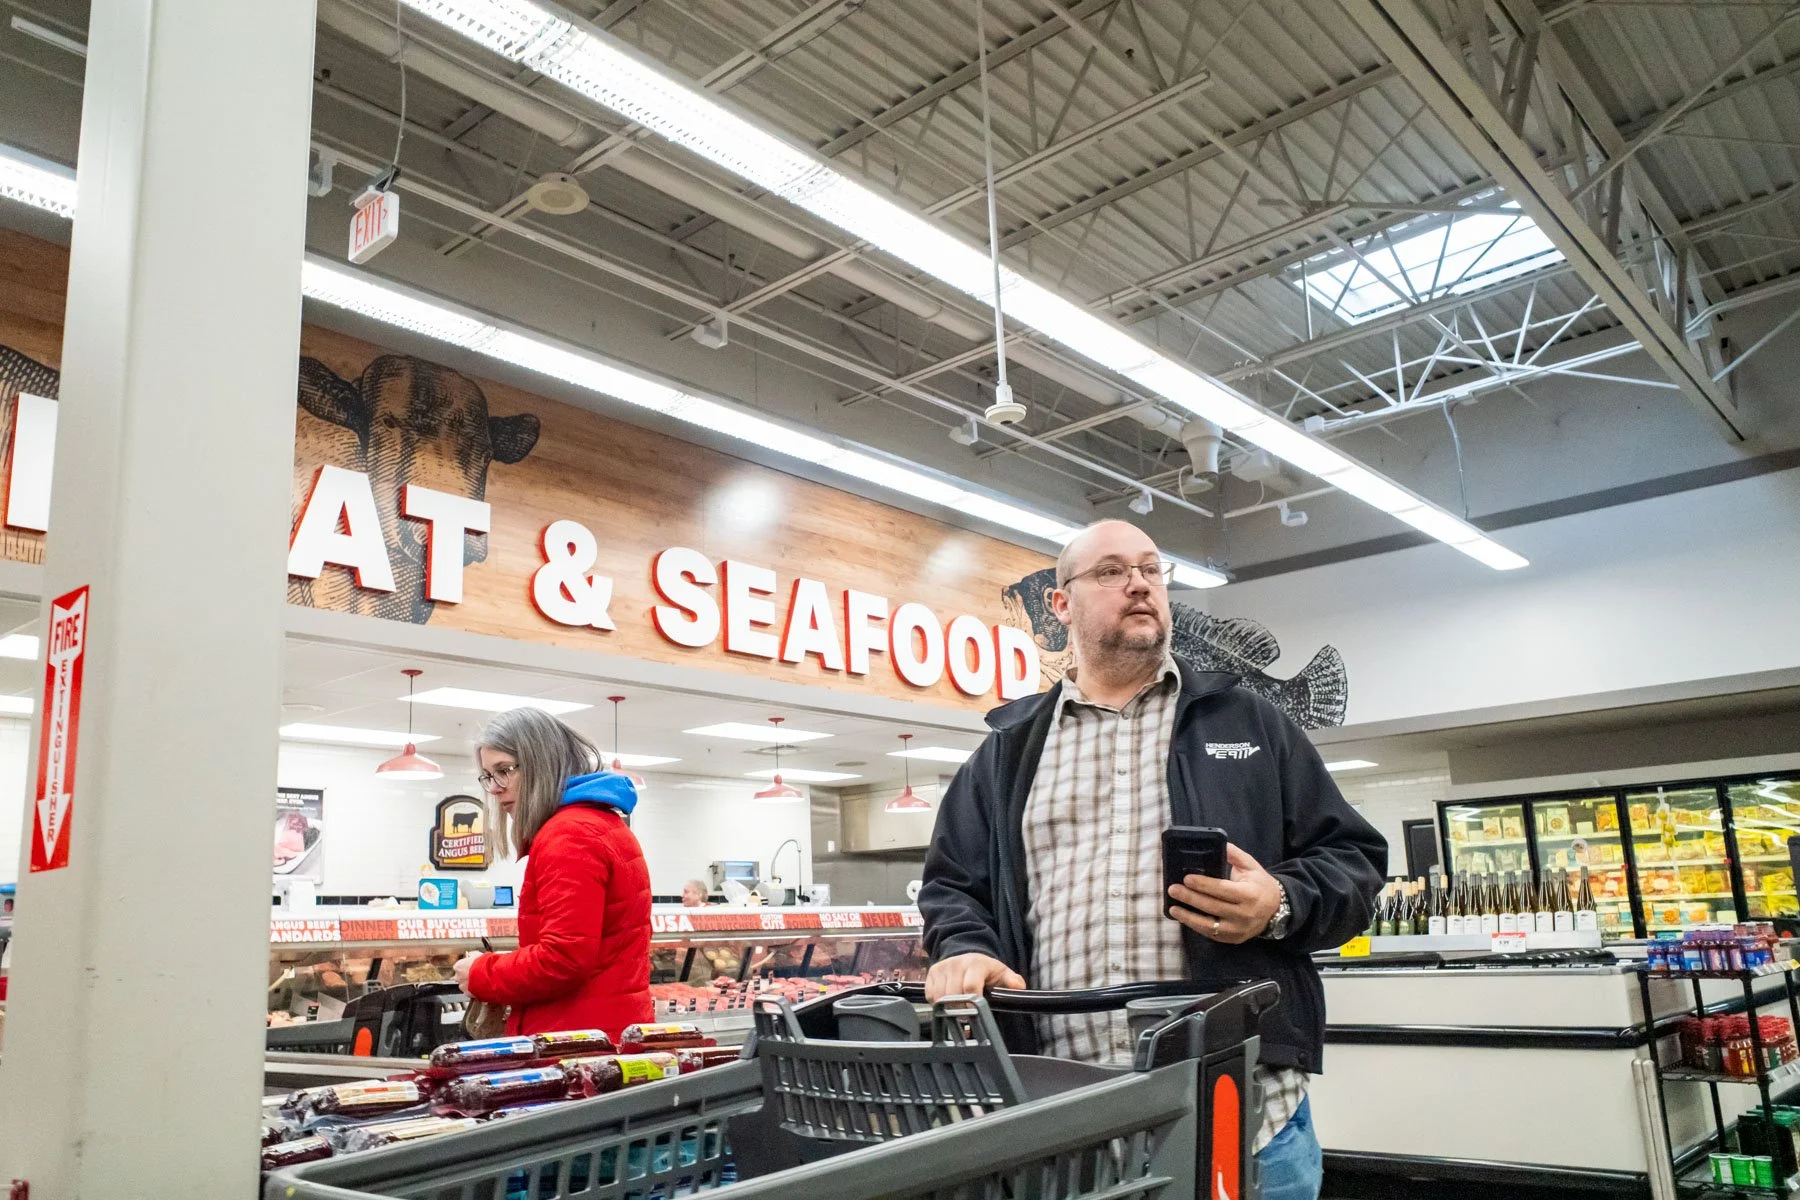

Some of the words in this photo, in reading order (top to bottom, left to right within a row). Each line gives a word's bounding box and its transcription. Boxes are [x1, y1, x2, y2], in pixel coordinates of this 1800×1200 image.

[354, 195, 384, 252] EXIT
[529, 519, 617, 632] &
[651, 546, 1041, 701] SEAFOOD
[53, 613, 80, 655] FIRE
[47, 659, 68, 842] EXTINGUISHER
[1215, 750, 1248, 759] E911
[441, 835, 484, 848] CERTIFIED
[438, 846, 468, 857] ANGUS
[819, 912, 831, 921] NO
[831, 912, 848, 921] SALT
[860, 912, 905, 927] NEVER
[340, 920, 394, 932] DINNER
[397, 920, 425, 930] OUR
[426, 919, 488, 930] BUTCHERS
[650, 914, 695, 932] USA
[761, 919, 785, 930] CUTS
[397, 930, 434, 940] MAKE
[434, 929, 446, 939] IT
[448, 928, 488, 939] BETTER
